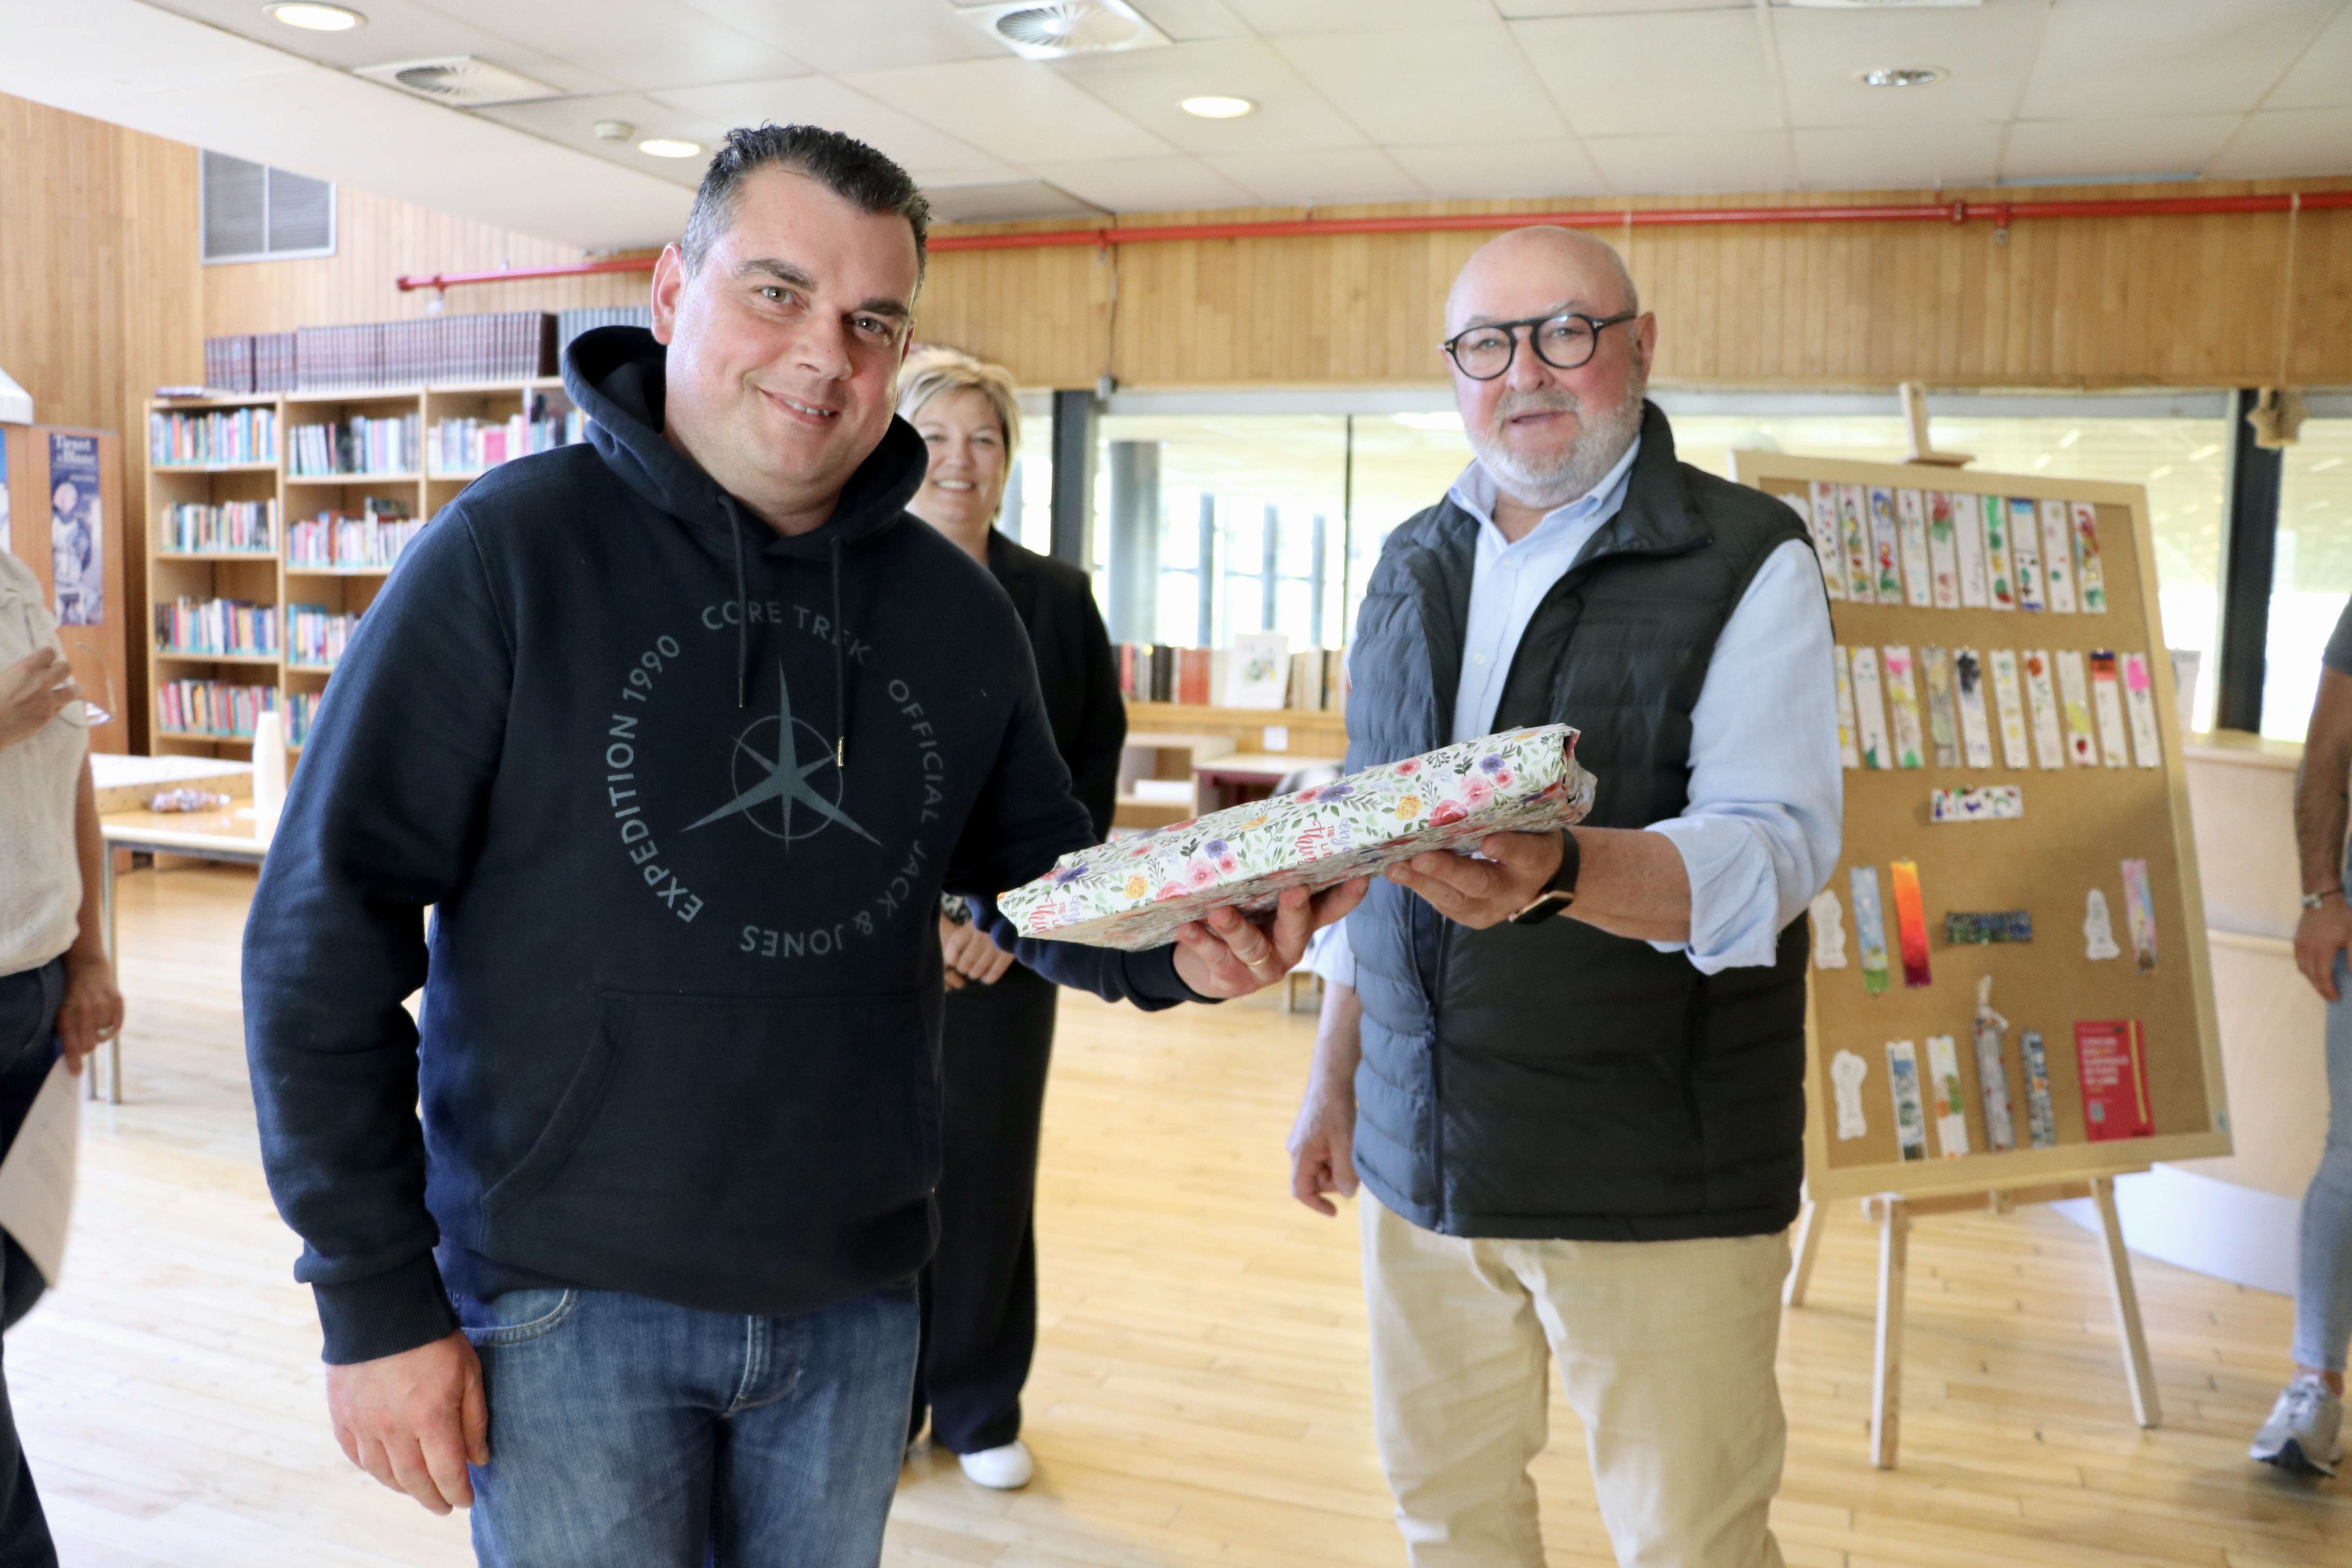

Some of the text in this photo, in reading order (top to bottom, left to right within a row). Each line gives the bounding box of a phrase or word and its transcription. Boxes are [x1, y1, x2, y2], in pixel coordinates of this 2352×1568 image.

[702, 601, 782, 630] CORE
[606, 635, 704, 923] EXPEDITION 1990
[740, 679, 943, 958] OFFICIAL JACK & JONES
[1331, 818, 1354, 852] enjo
